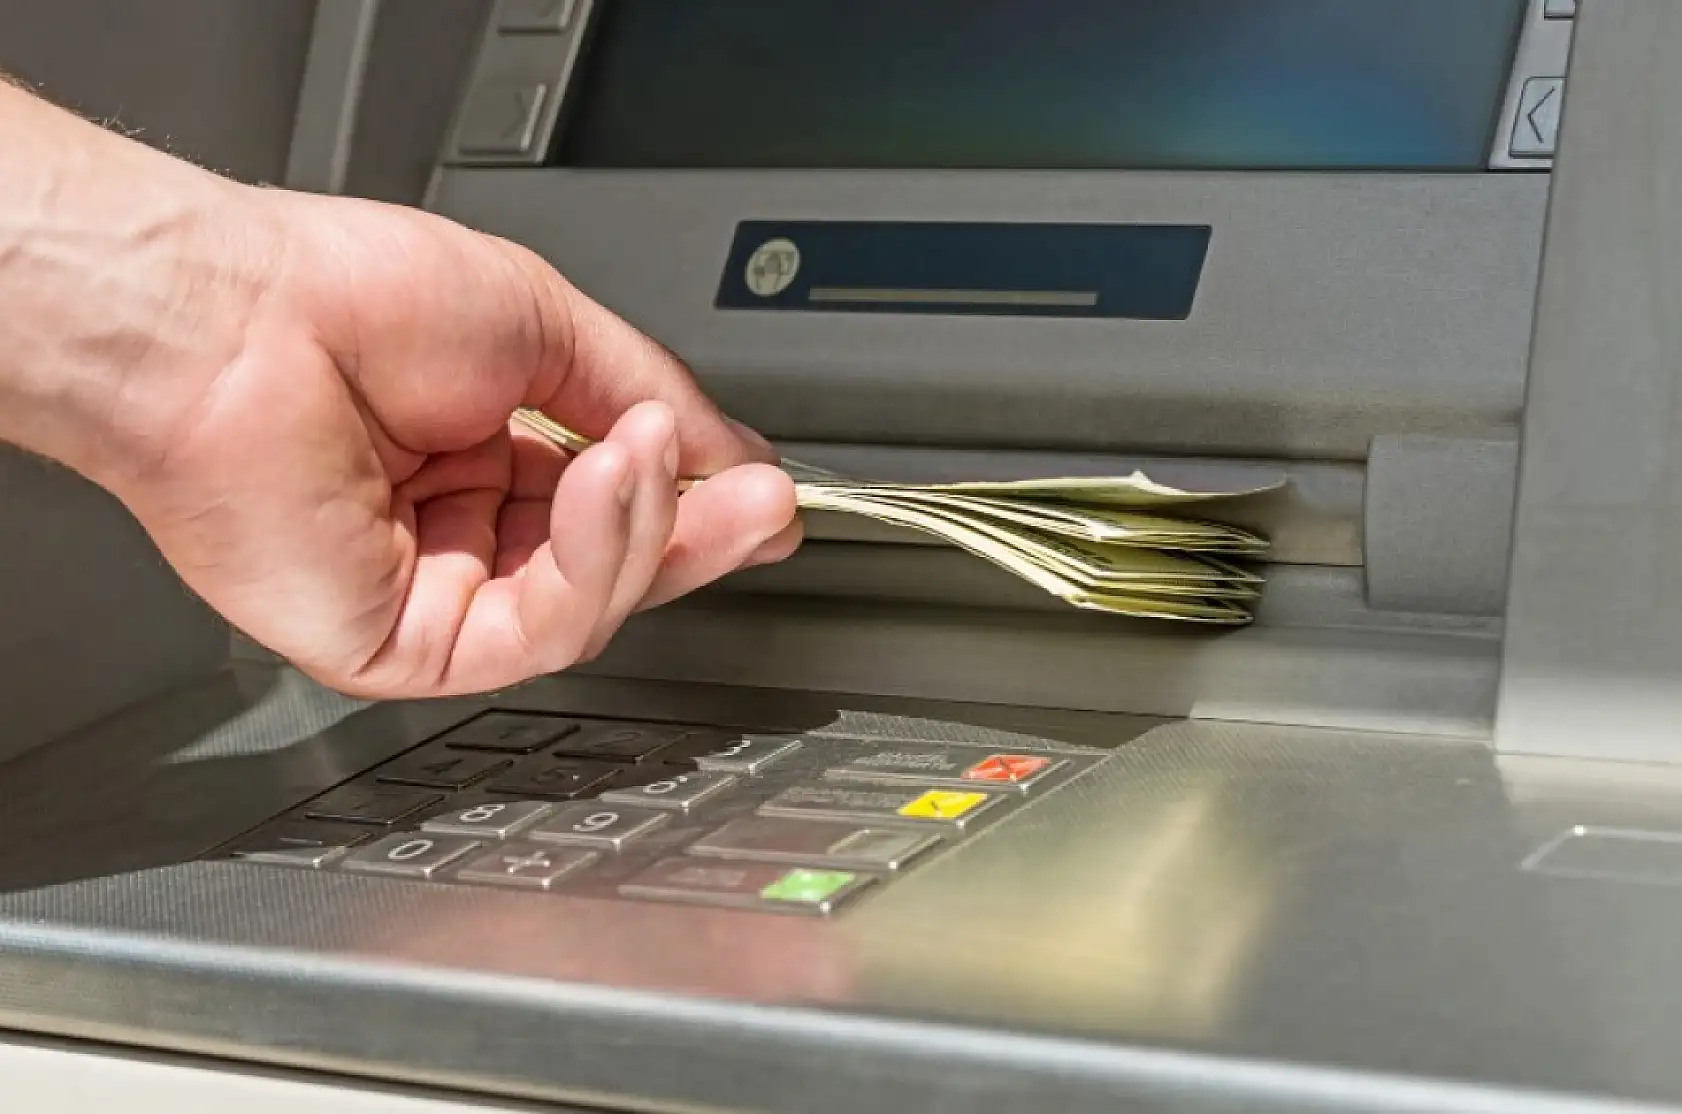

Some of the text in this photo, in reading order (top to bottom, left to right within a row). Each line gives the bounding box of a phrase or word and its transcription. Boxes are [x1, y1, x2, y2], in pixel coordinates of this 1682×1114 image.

[421, 758, 464, 775] 4
[643, 775, 688, 794] 6
[459, 803, 506, 823] 8
[573, 811, 619, 832] 9
[388, 839, 434, 860] 0
